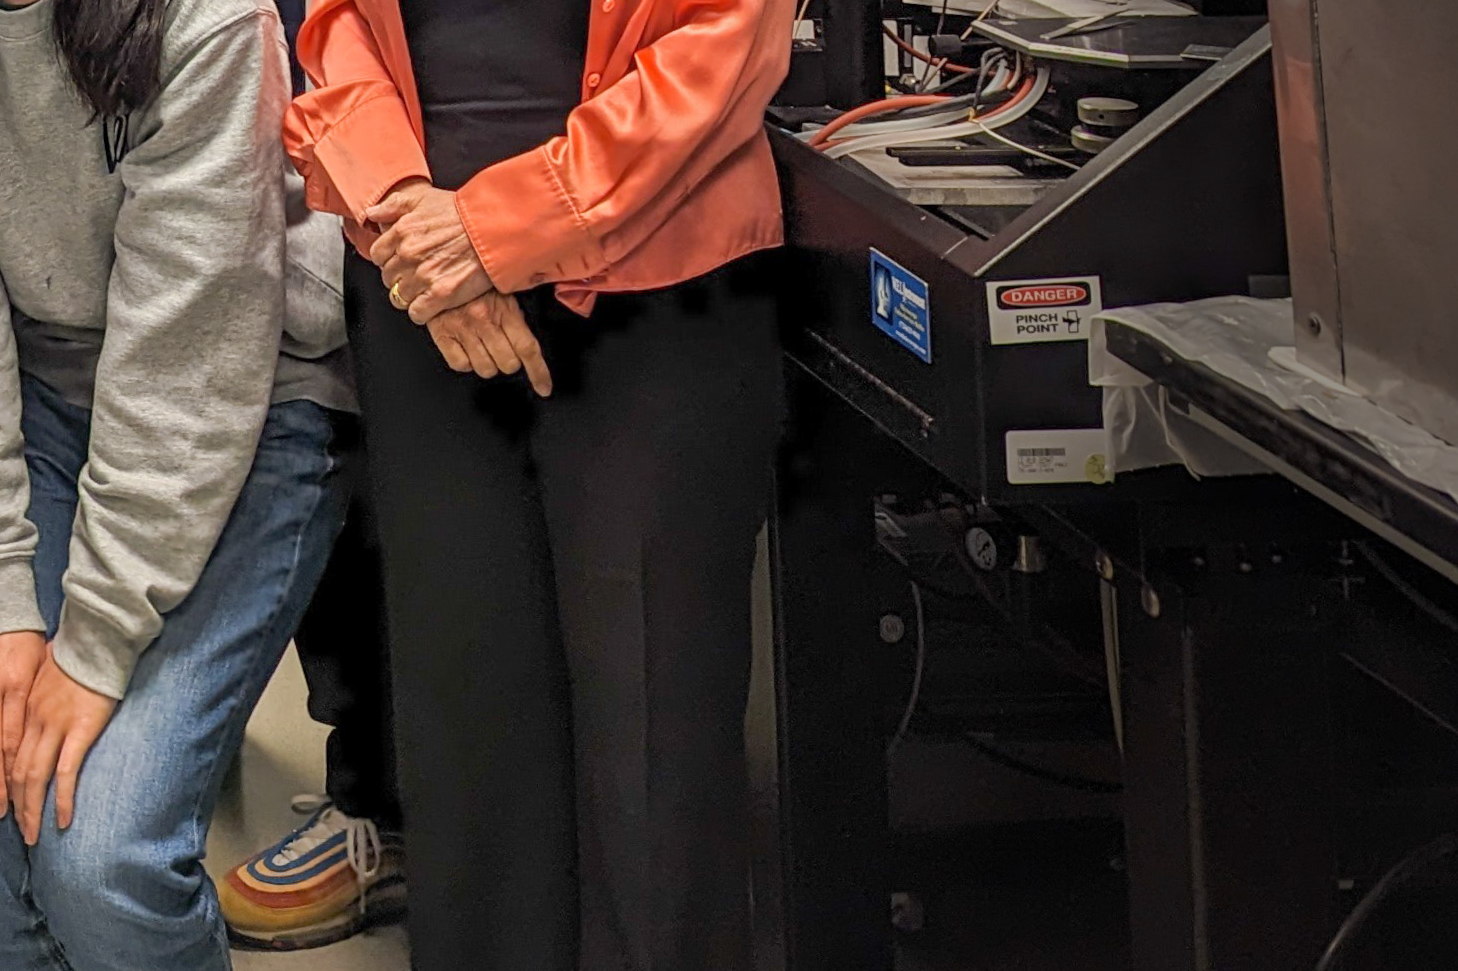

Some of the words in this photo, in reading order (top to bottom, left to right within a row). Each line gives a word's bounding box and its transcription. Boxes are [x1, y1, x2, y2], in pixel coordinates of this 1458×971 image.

[1011, 289, 1077, 302] DANGER
[1016, 313, 1058, 324] PINCH
[1016, 323, 1059, 334] POINT
